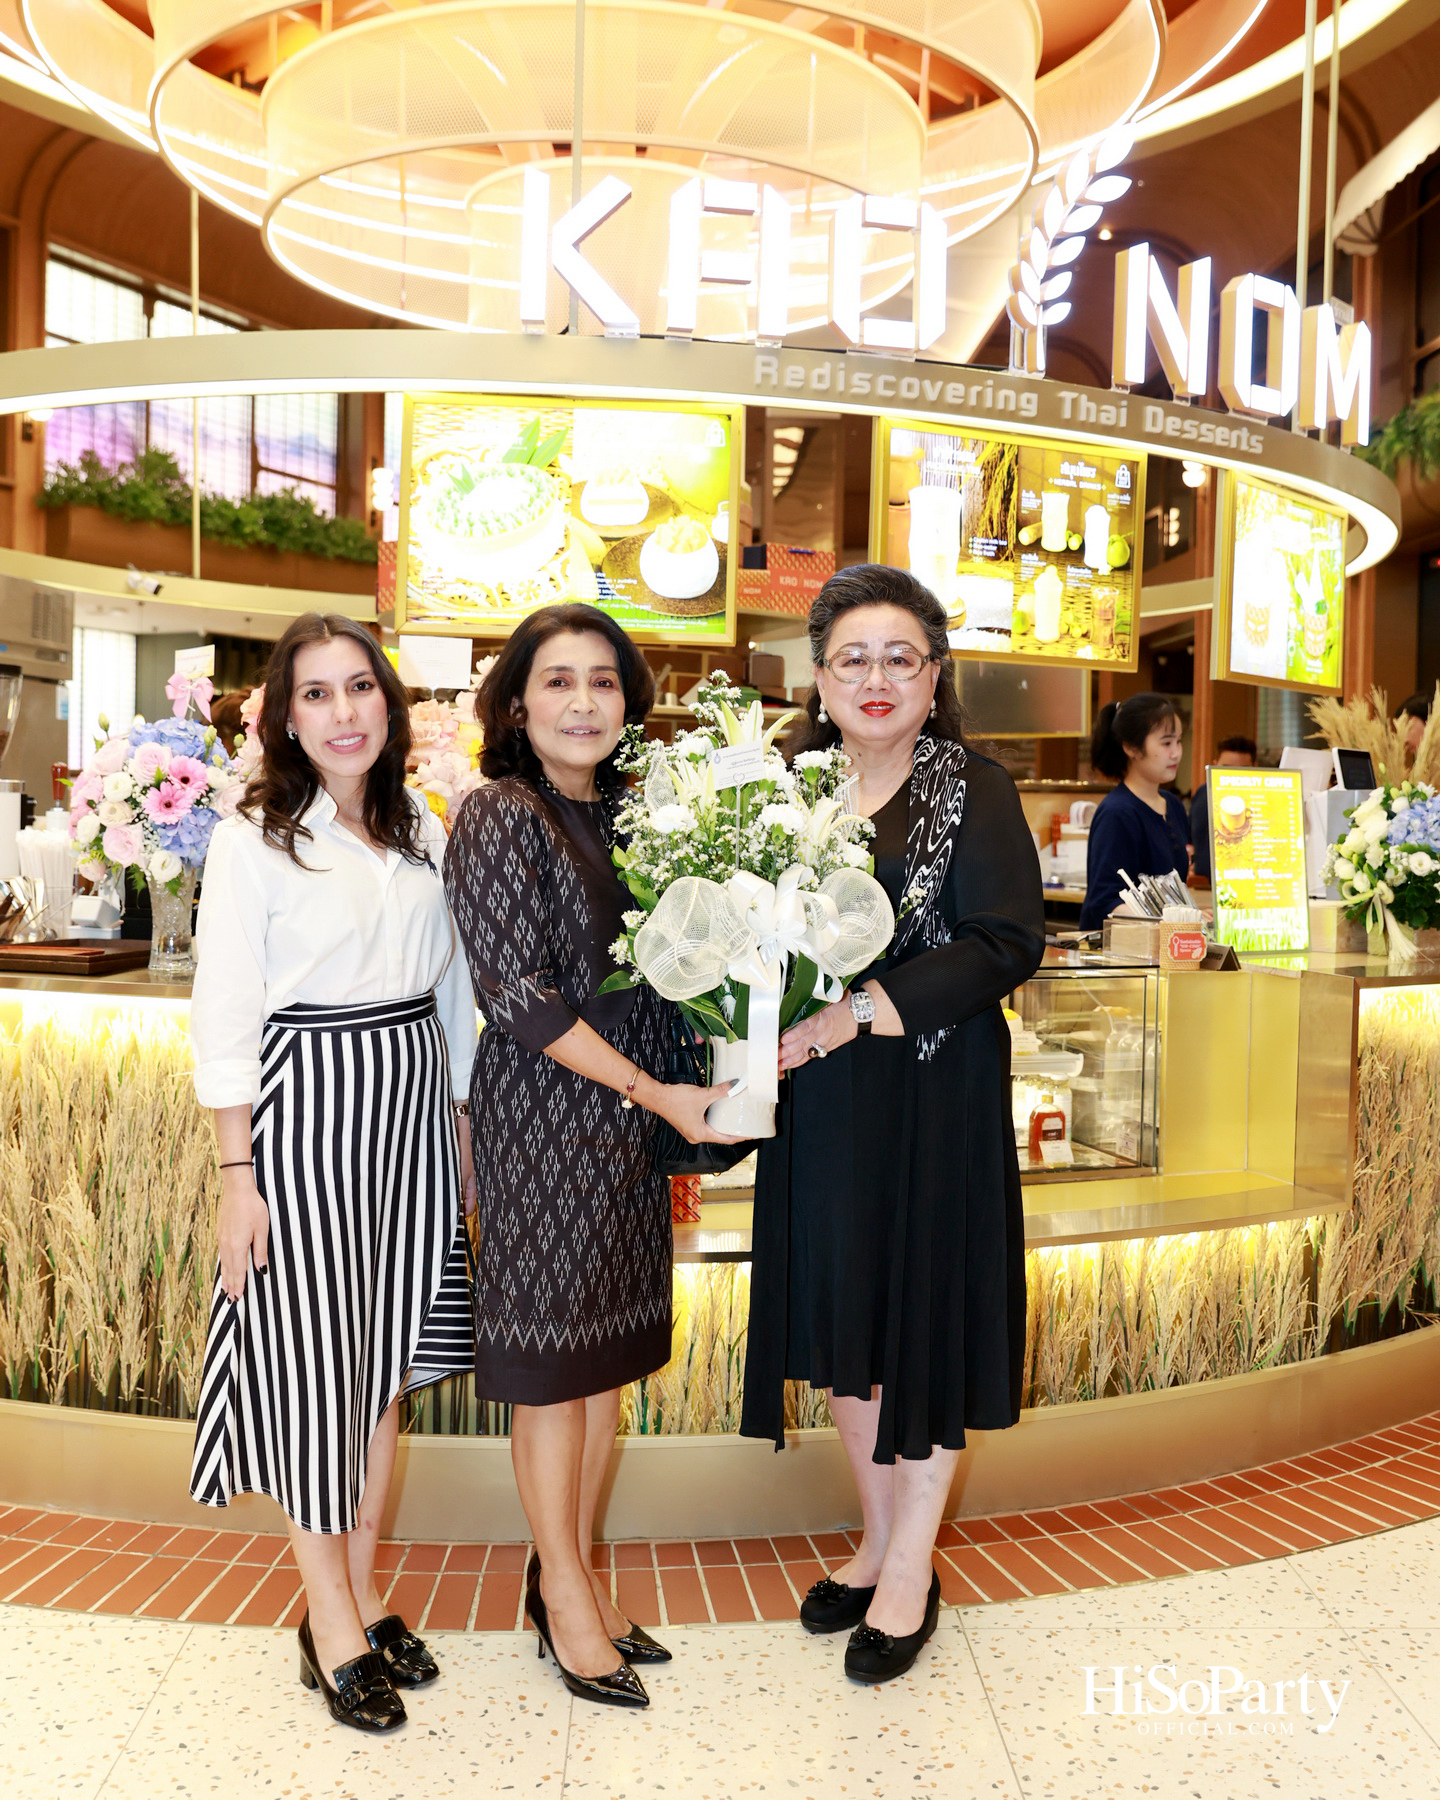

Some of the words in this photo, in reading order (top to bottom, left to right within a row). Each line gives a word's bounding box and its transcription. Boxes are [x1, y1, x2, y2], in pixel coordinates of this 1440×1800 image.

[520, 164, 948, 350] KAO
[1112, 241, 1372, 446] NOM
[755, 355, 1038, 418] Rediscovering
[1058, 391, 1128, 428] Thai
[1144, 405, 1265, 454] Desserts
[1219, 775, 1262, 787] SPECIALTY
